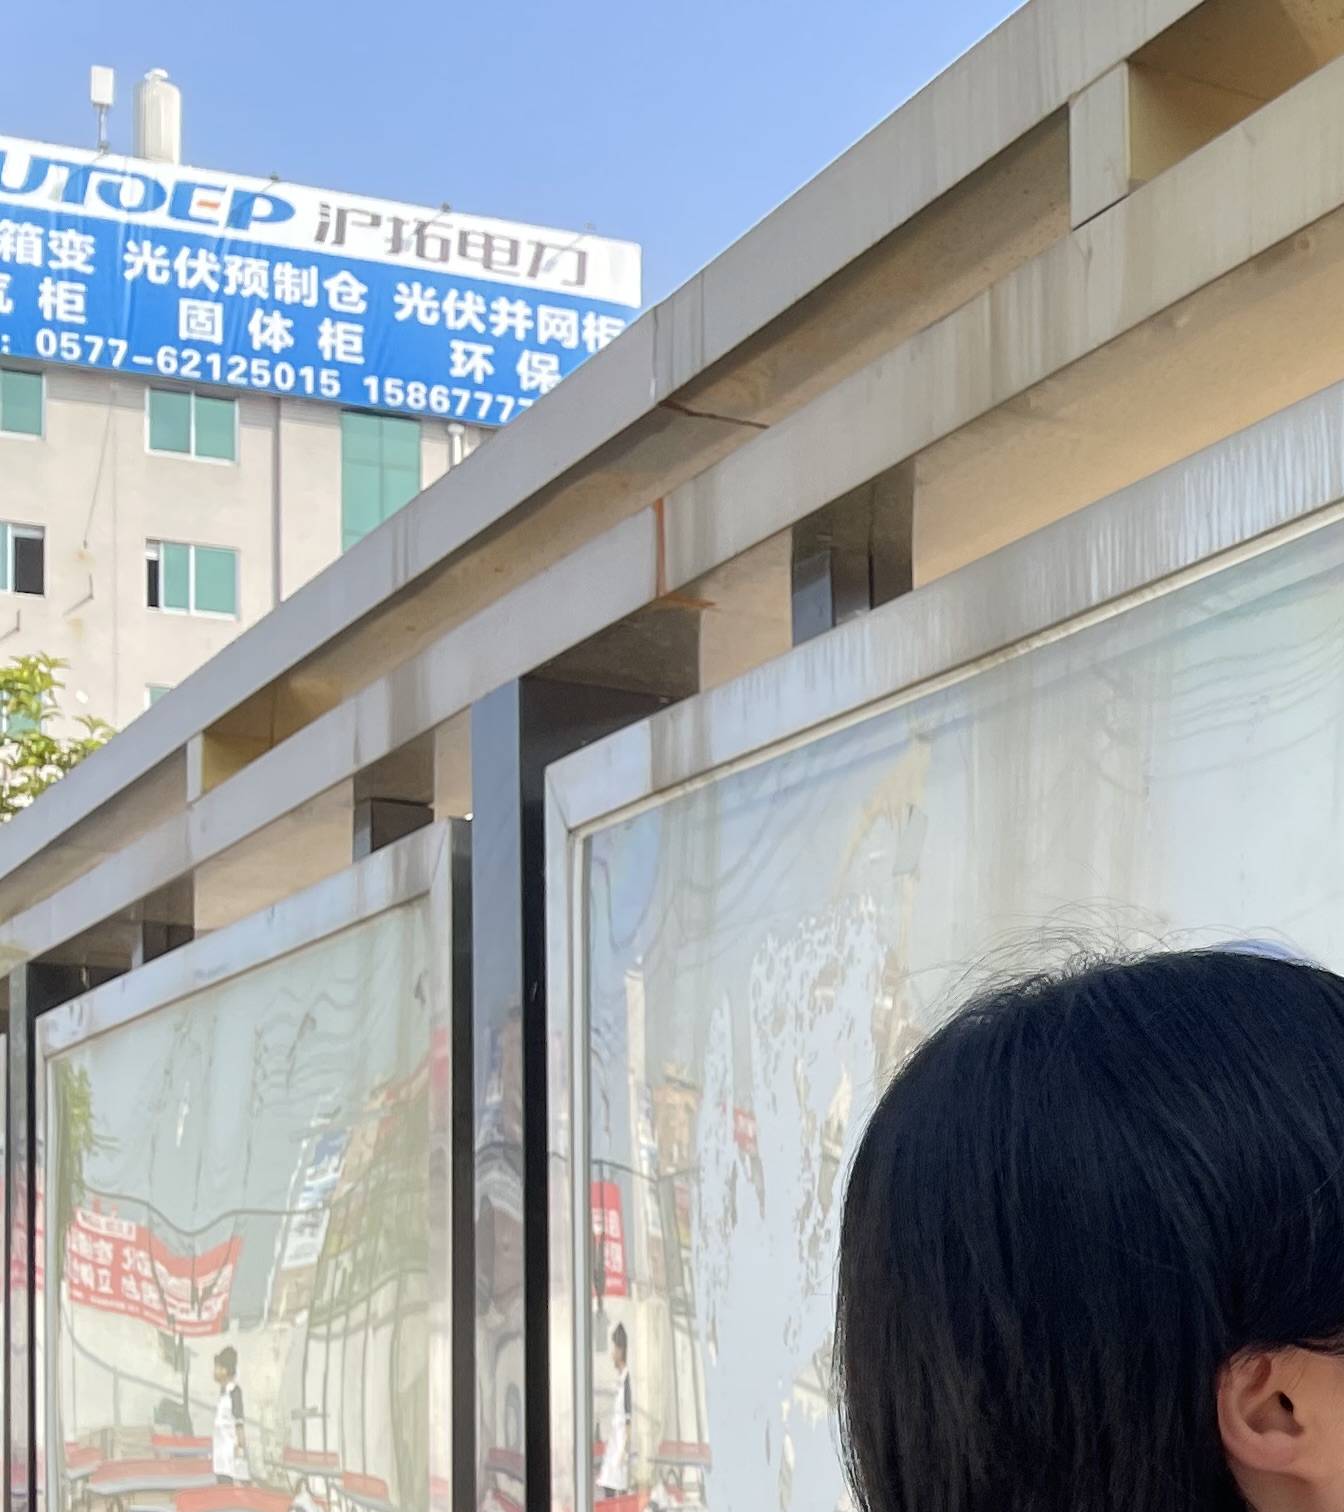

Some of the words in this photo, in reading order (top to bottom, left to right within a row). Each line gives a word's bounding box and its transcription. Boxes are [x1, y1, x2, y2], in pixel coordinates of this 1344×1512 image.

[0, 218, 95, 275] 箱变
[123, 240, 368, 314] 光伏预制仓
[314, 201, 588, 287] 沪拓电力
[36, 328, 341, 398] 0577-62125015
